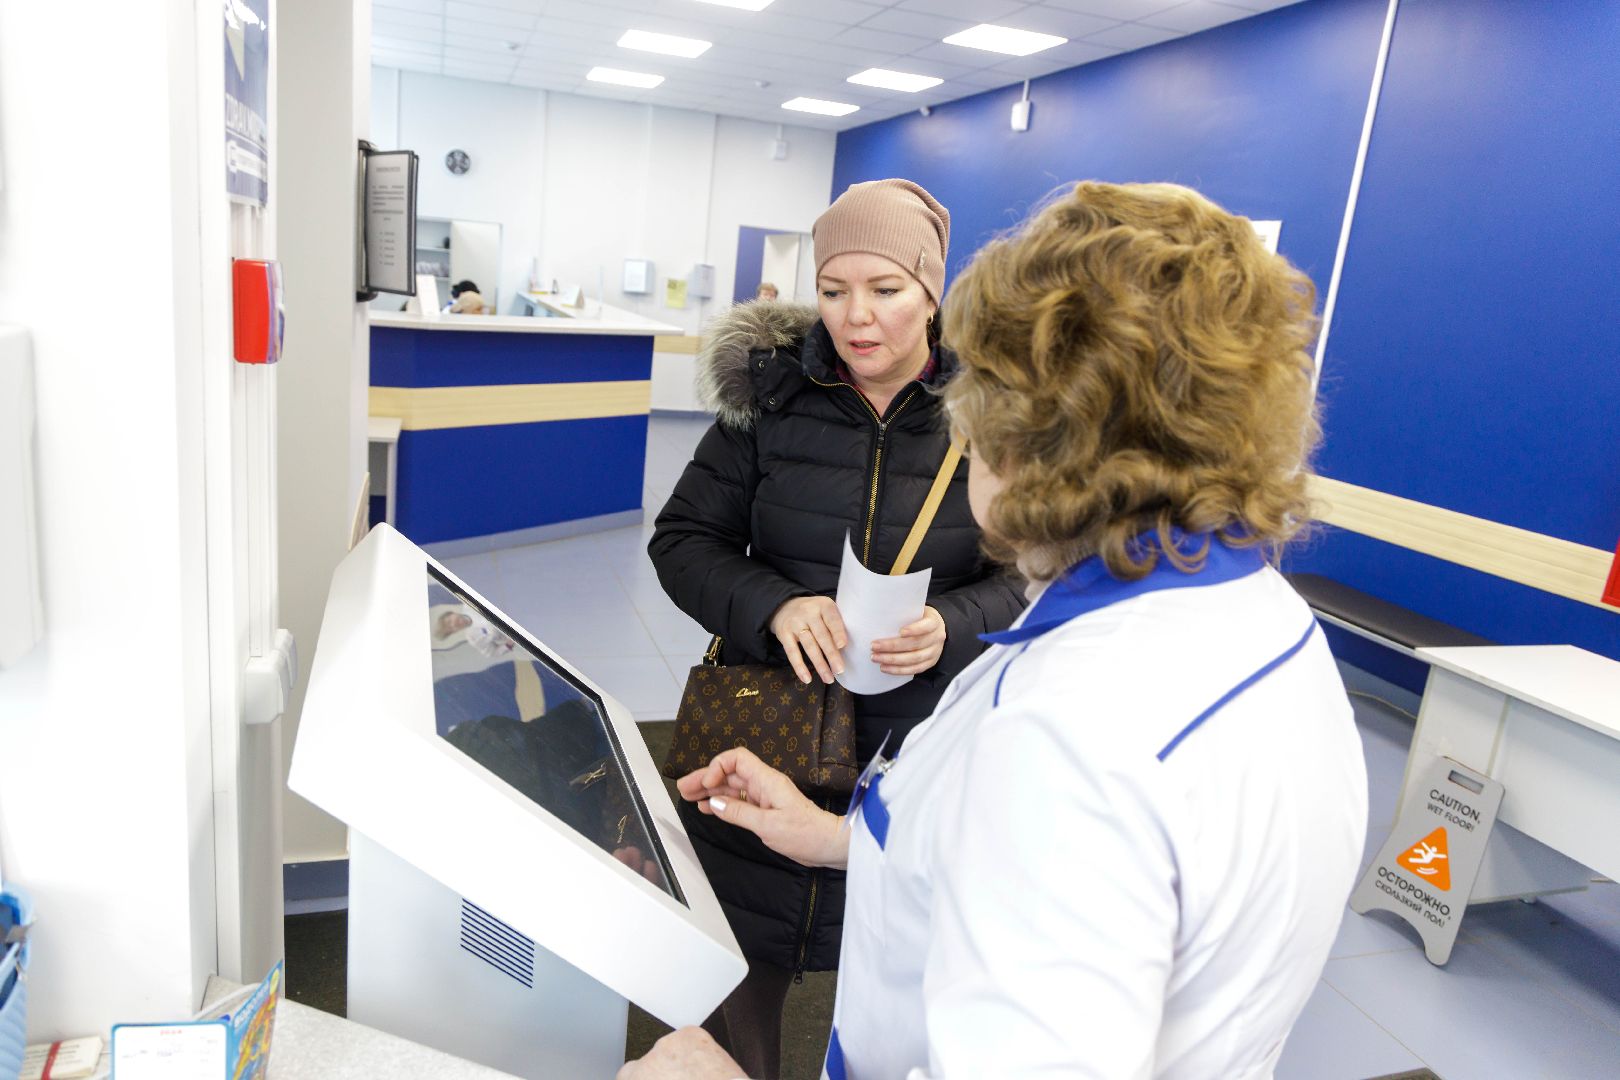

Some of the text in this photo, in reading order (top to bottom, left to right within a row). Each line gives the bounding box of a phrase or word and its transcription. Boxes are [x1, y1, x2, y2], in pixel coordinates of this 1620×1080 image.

[1427, 803, 1475, 832] WET FLOOR!
[1430, 789, 1480, 824] CAUTION,
[1375, 880, 1445, 928] СКОЛЬЗКИЙ ПОЛ!
[1377, 866, 1451, 920] ОСТОРОЖНО,
